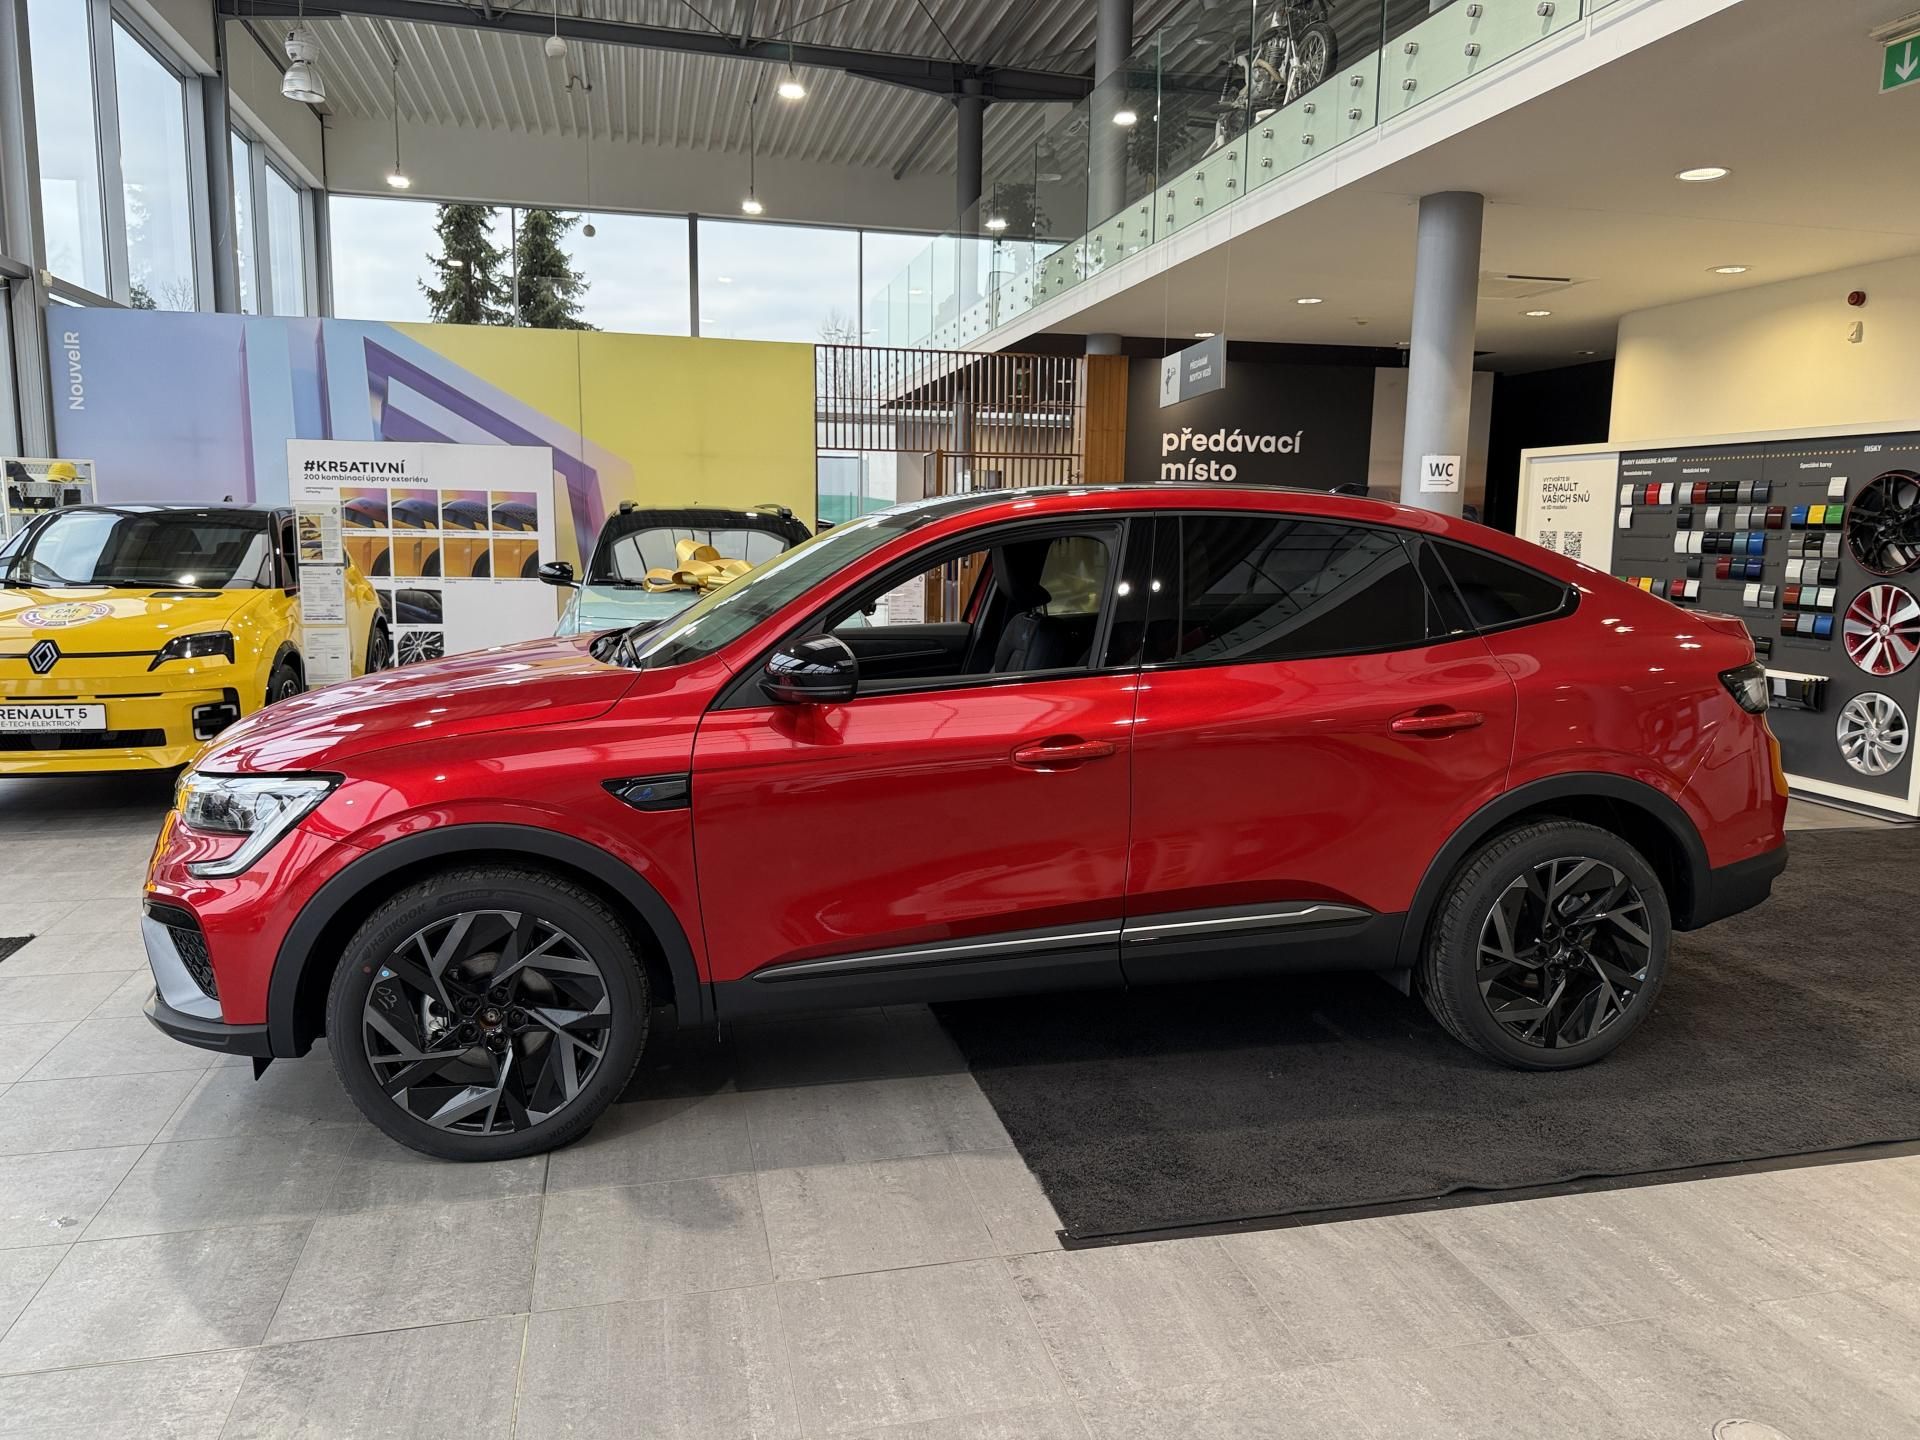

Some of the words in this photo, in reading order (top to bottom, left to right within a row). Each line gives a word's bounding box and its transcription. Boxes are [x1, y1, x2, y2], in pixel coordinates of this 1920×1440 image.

[64, 331, 85, 411] NouvelR
[1161, 426, 1304, 457] předávací
[1863, 444, 1882, 453] DISKY
[303, 459, 405, 474] #KR5ATIVNÍ
[1161, 458, 1238, 481] místo
[1429, 462, 1454, 477] WC
[321, 473, 365, 481] kombinací
[366, 474, 390, 483] úprav
[391, 475, 429, 483] exteriéru
[1542, 482, 1579, 492] RENAULT
[1541, 492, 1571, 503] VAŠICH
[1572, 490, 1590, 502] SNŮ
[78, 708, 88, 719] 5
[1, 720, 31, 728] E-TECH
[32, 719, 82, 727] ELEKTRICKÝ
